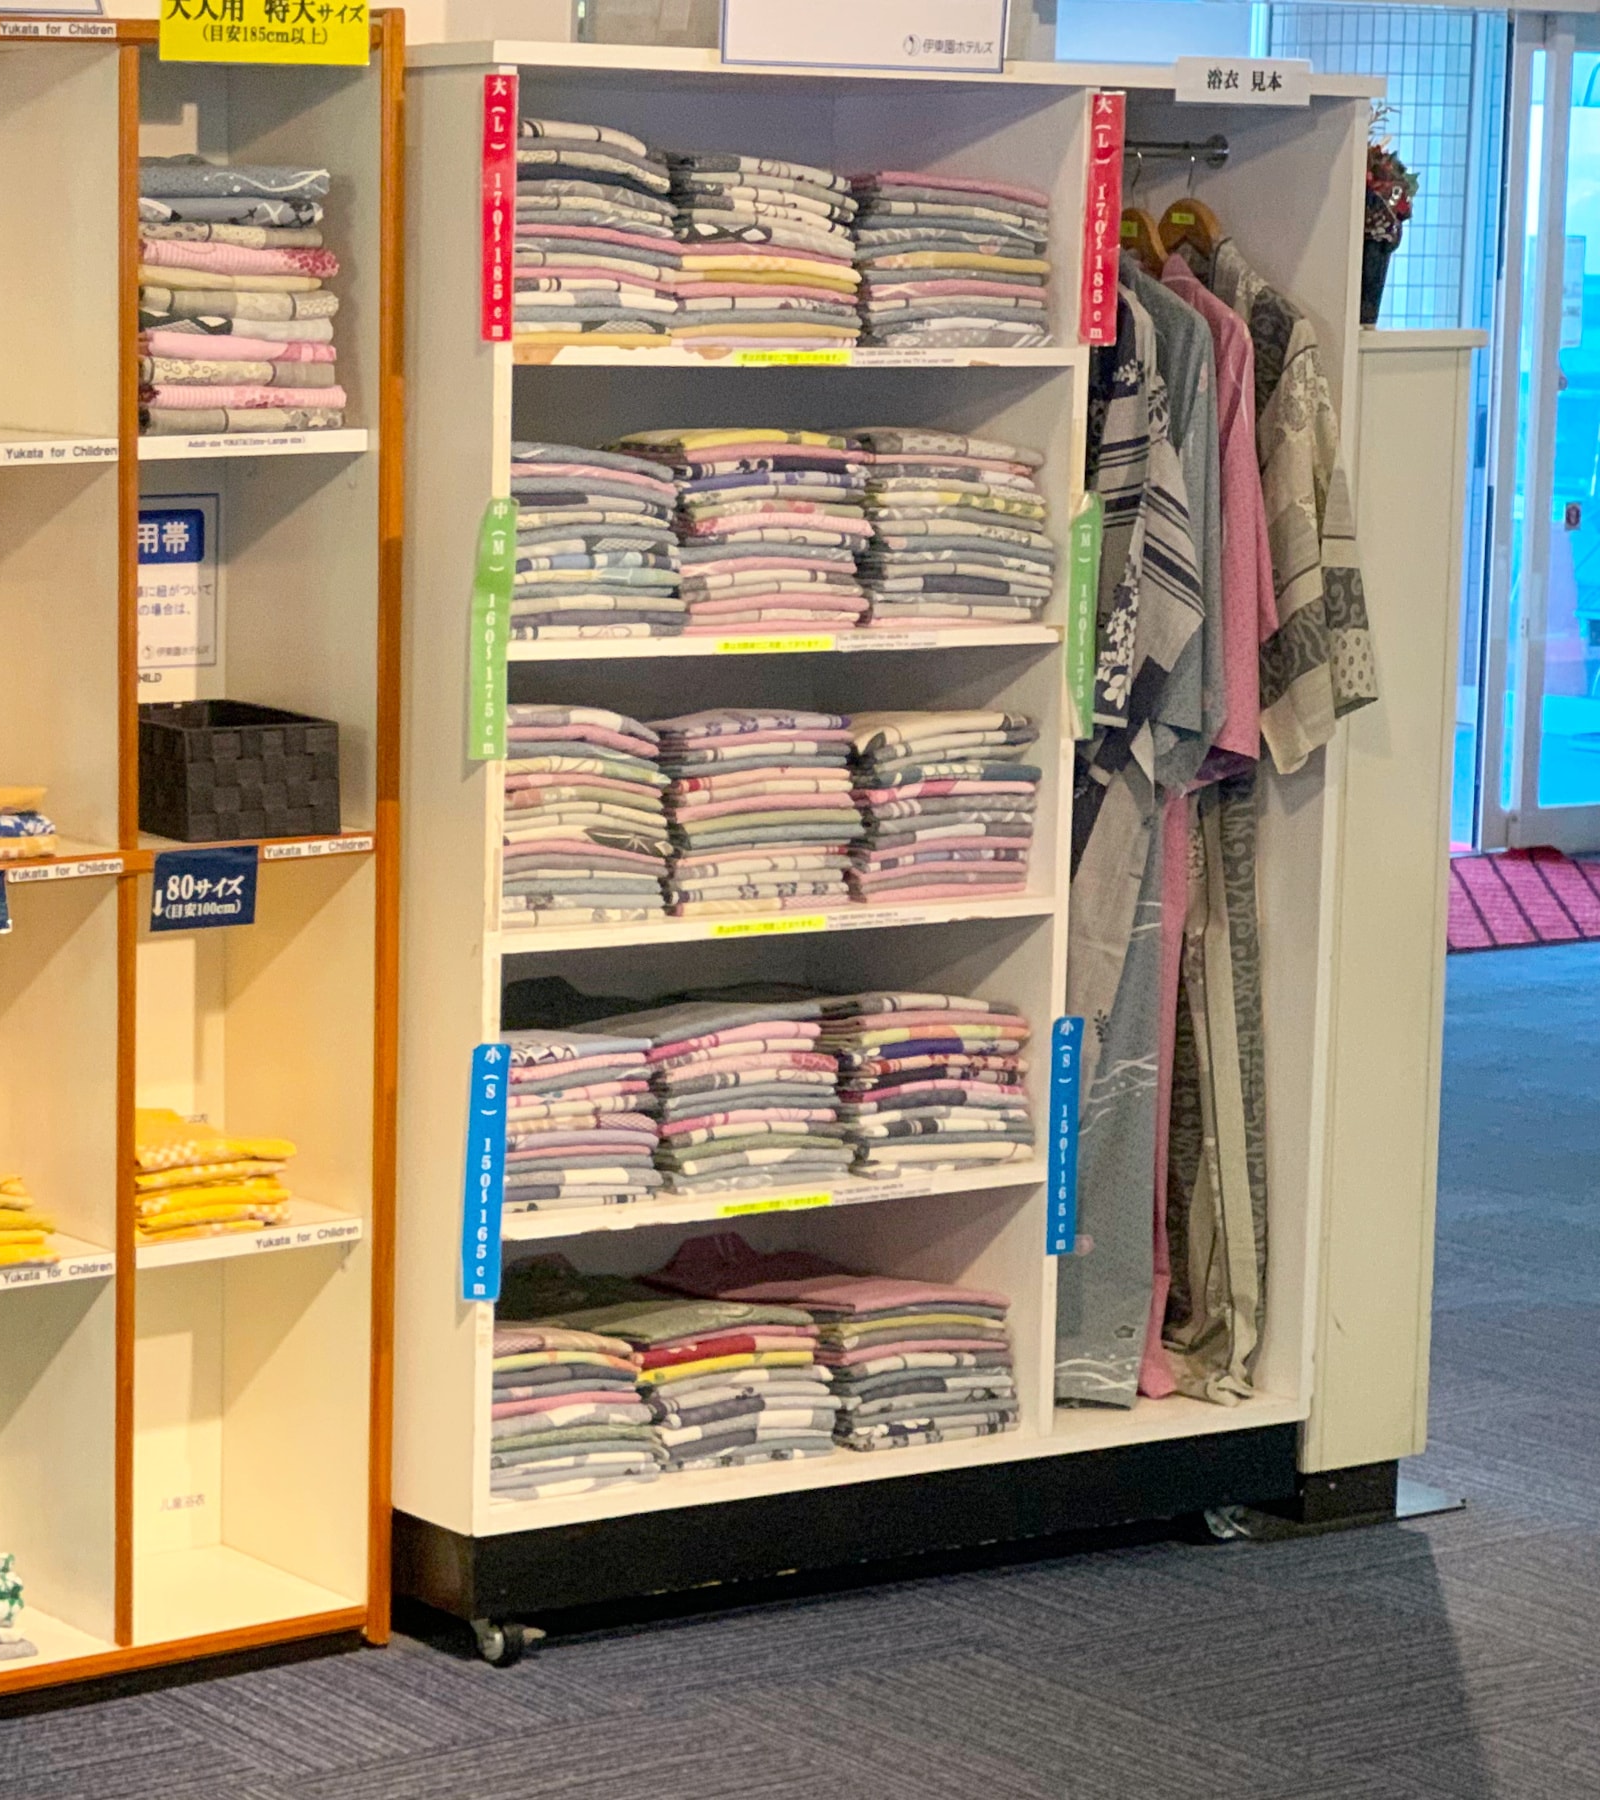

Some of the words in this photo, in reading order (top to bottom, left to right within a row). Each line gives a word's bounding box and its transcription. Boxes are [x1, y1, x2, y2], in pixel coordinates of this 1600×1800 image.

[0, 24, 39, 36] Yukata
[46, 24, 62, 35] for
[68, 24, 114, 36] Children
[1207, 67, 1239, 90] 浴衣
[1251, 70, 1282, 92] 見本
[5, 448, 44, 460] Yukata
[50, 447, 66, 458] for
[72, 446, 118, 458] Children
[265, 846, 302, 858] Yukata
[307, 844, 322, 855] for
[328, 839, 370, 852] Children
[11, 869, 49, 881] Yukata
[55, 865, 70, 876] for
[77, 861, 122, 875] Children
[165, 875, 245, 901] 80サイズ
[255, 1236, 291, 1249] Yukata
[297, 1232, 312, 1243] for
[317, 1225, 359, 1239] Children
[2, 1271, 41, 1284] Yukata
[46, 1267, 62, 1279] for
[68, 1261, 113, 1276] Children
